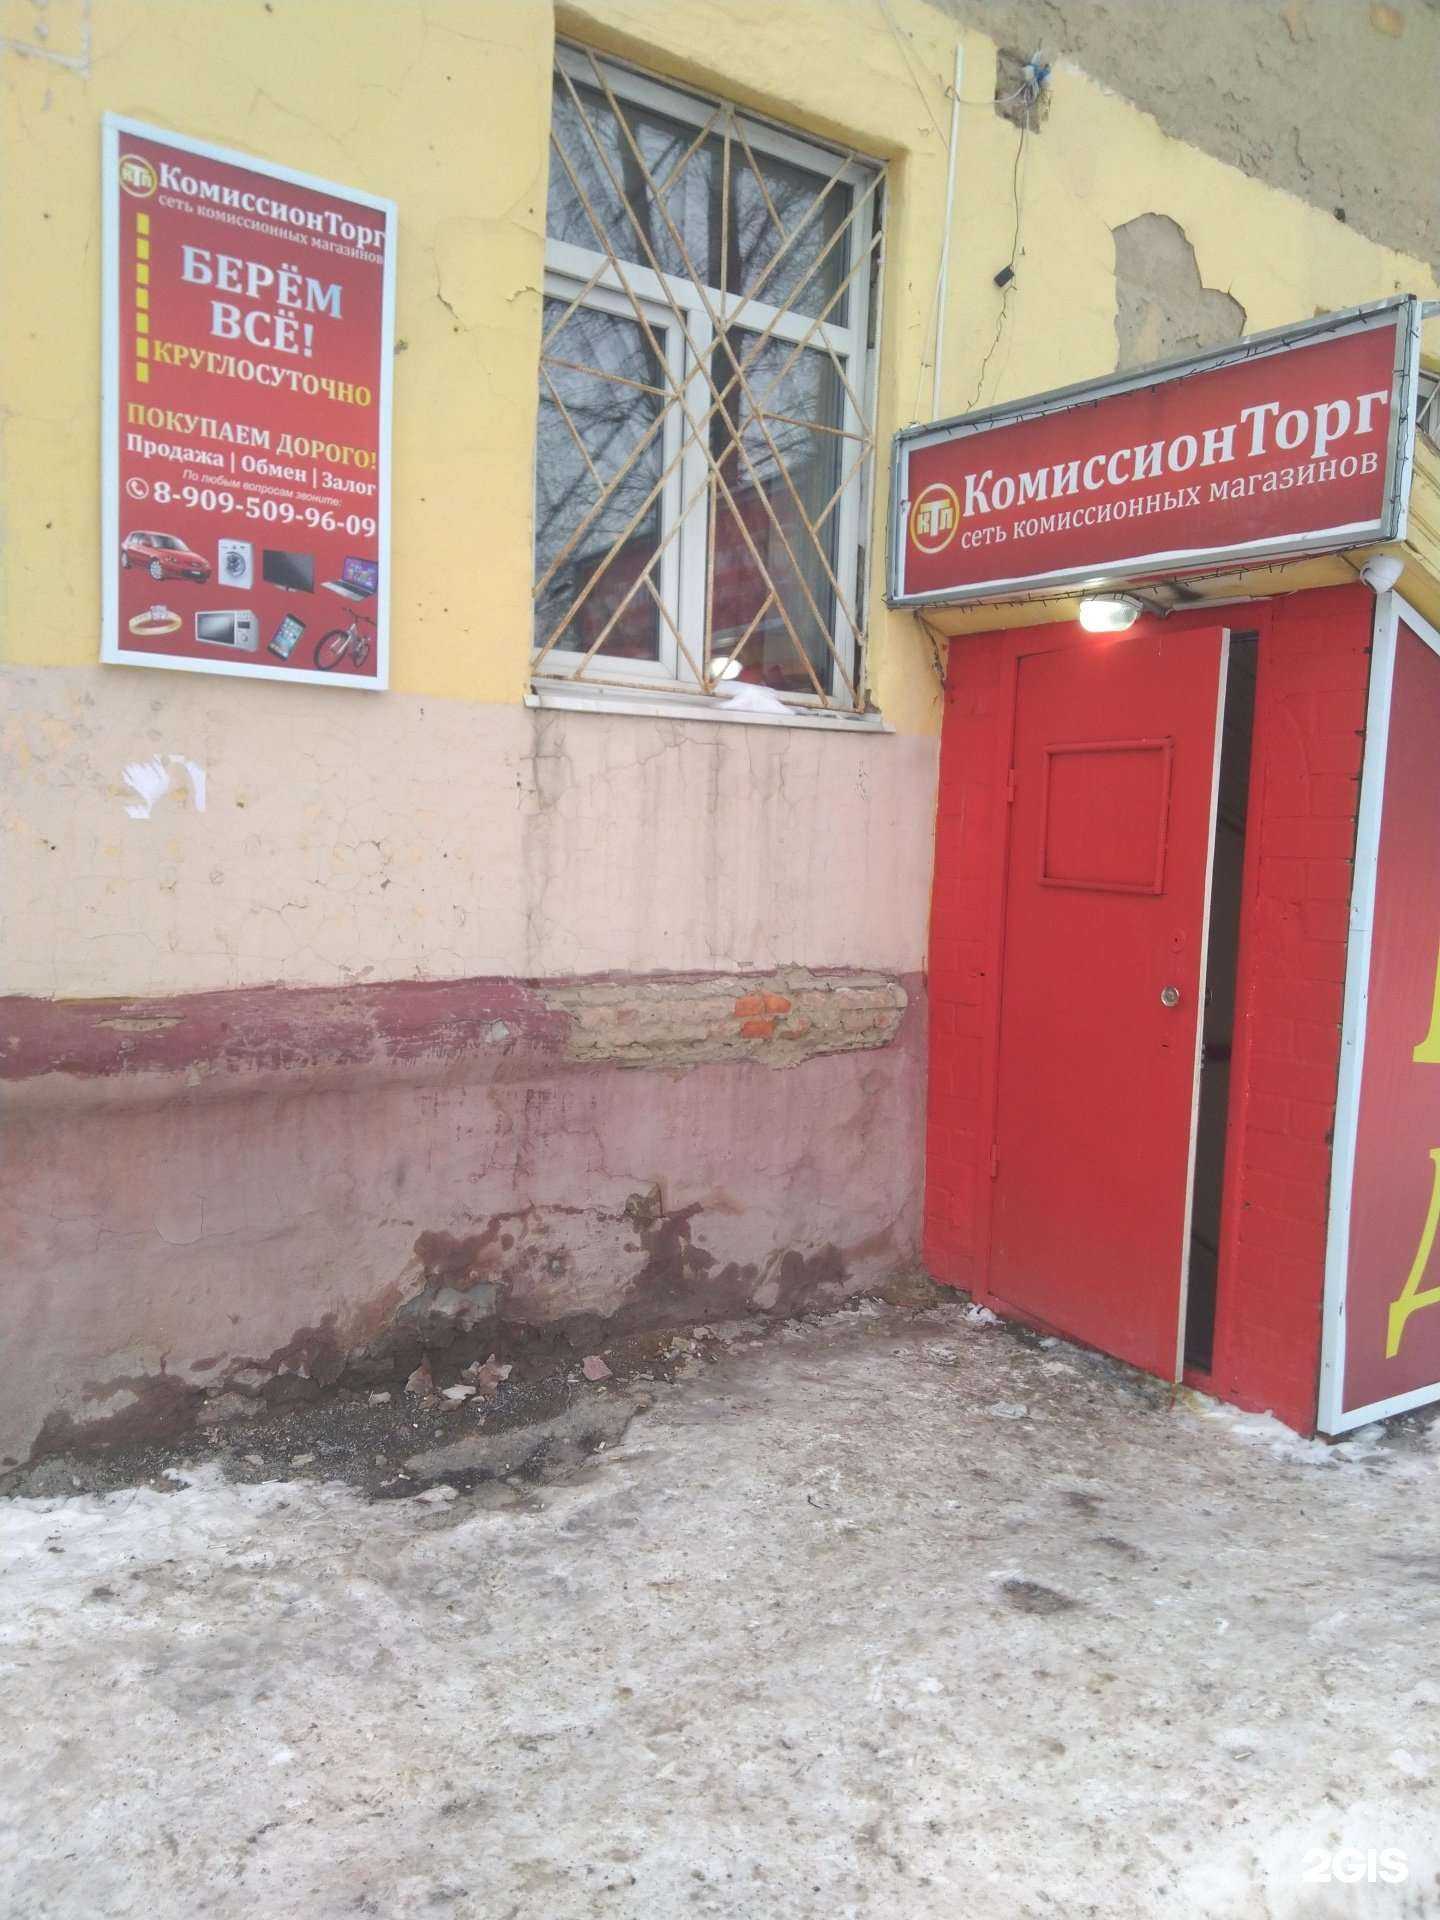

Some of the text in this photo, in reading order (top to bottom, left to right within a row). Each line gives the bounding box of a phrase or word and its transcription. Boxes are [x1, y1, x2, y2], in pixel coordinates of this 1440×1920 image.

[158, 194, 194, 213] сеть
[196, 206, 308, 246] комиссионных
[159, 162, 387, 249] КомиссионТорг
[181, 244, 342, 320] БЕРЁМ
[210, 300, 315, 358] ВСЁ!
[153, 340, 372, 406] КРУГЛОСУТОЧНО
[127, 402, 377, 470] ПОКУПАЕМ ДОРОГО!
[127, 433, 376, 496] Продажа Обмен Залог
[962, 389, 1388, 517] КомиссионТорг
[153, 480, 376, 537] 8-909-509-96-09
[182, 469, 199, 481] По
[201, 474, 241, 488] любым
[961, 451, 1379, 549] сеть комиссионных магазинов
